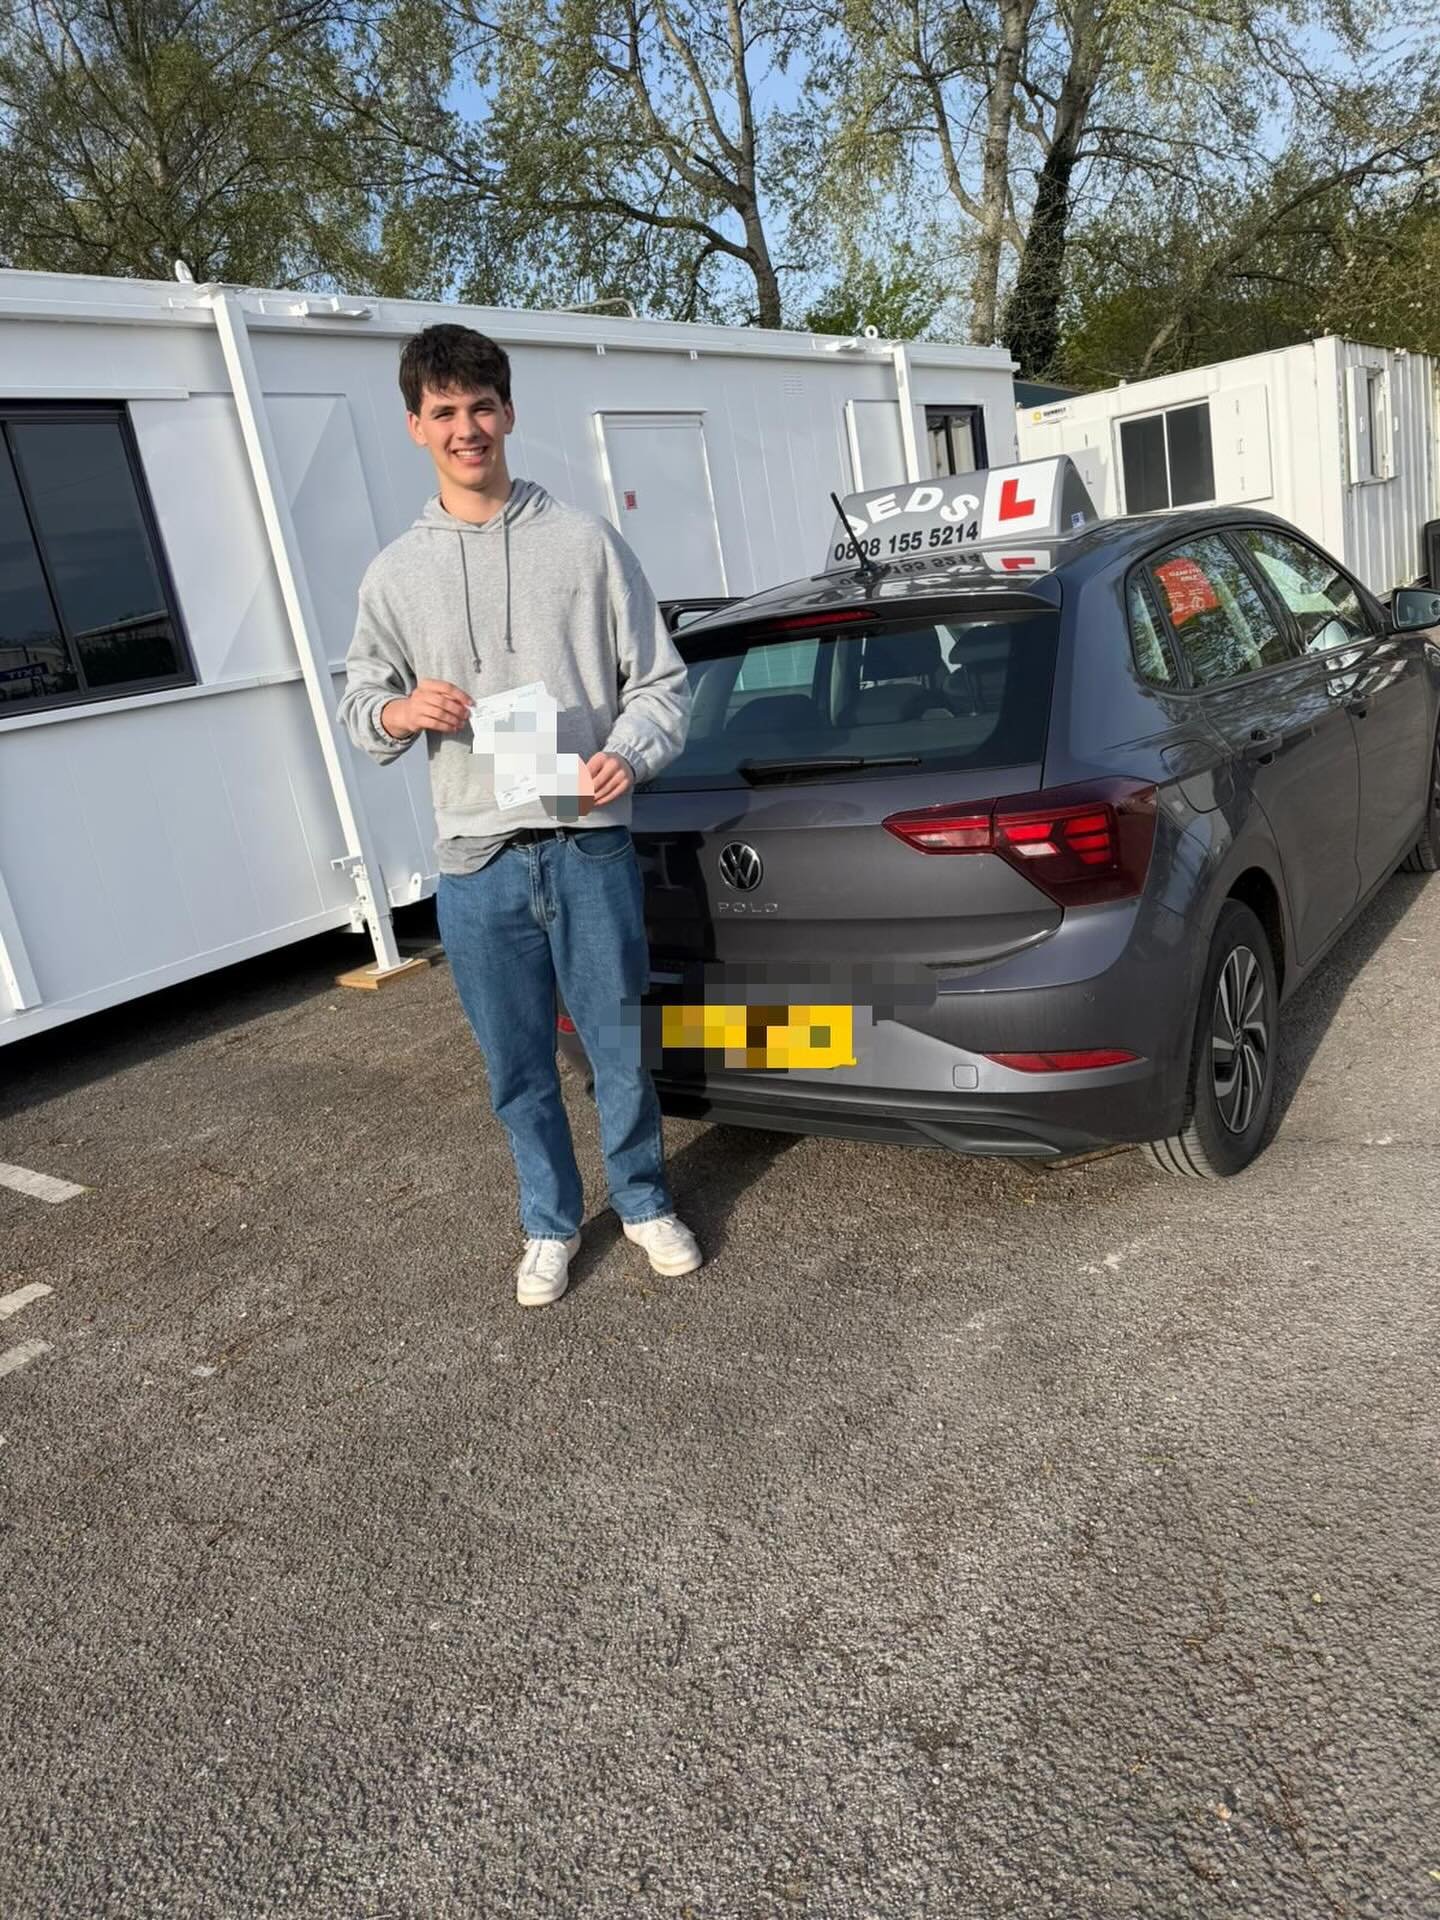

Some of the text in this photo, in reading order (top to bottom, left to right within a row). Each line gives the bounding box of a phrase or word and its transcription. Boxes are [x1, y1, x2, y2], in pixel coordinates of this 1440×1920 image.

[999, 479, 1035, 522] L
[834, 520, 978, 561] 0808 155 5214
[718, 902, 778, 913] POLO
